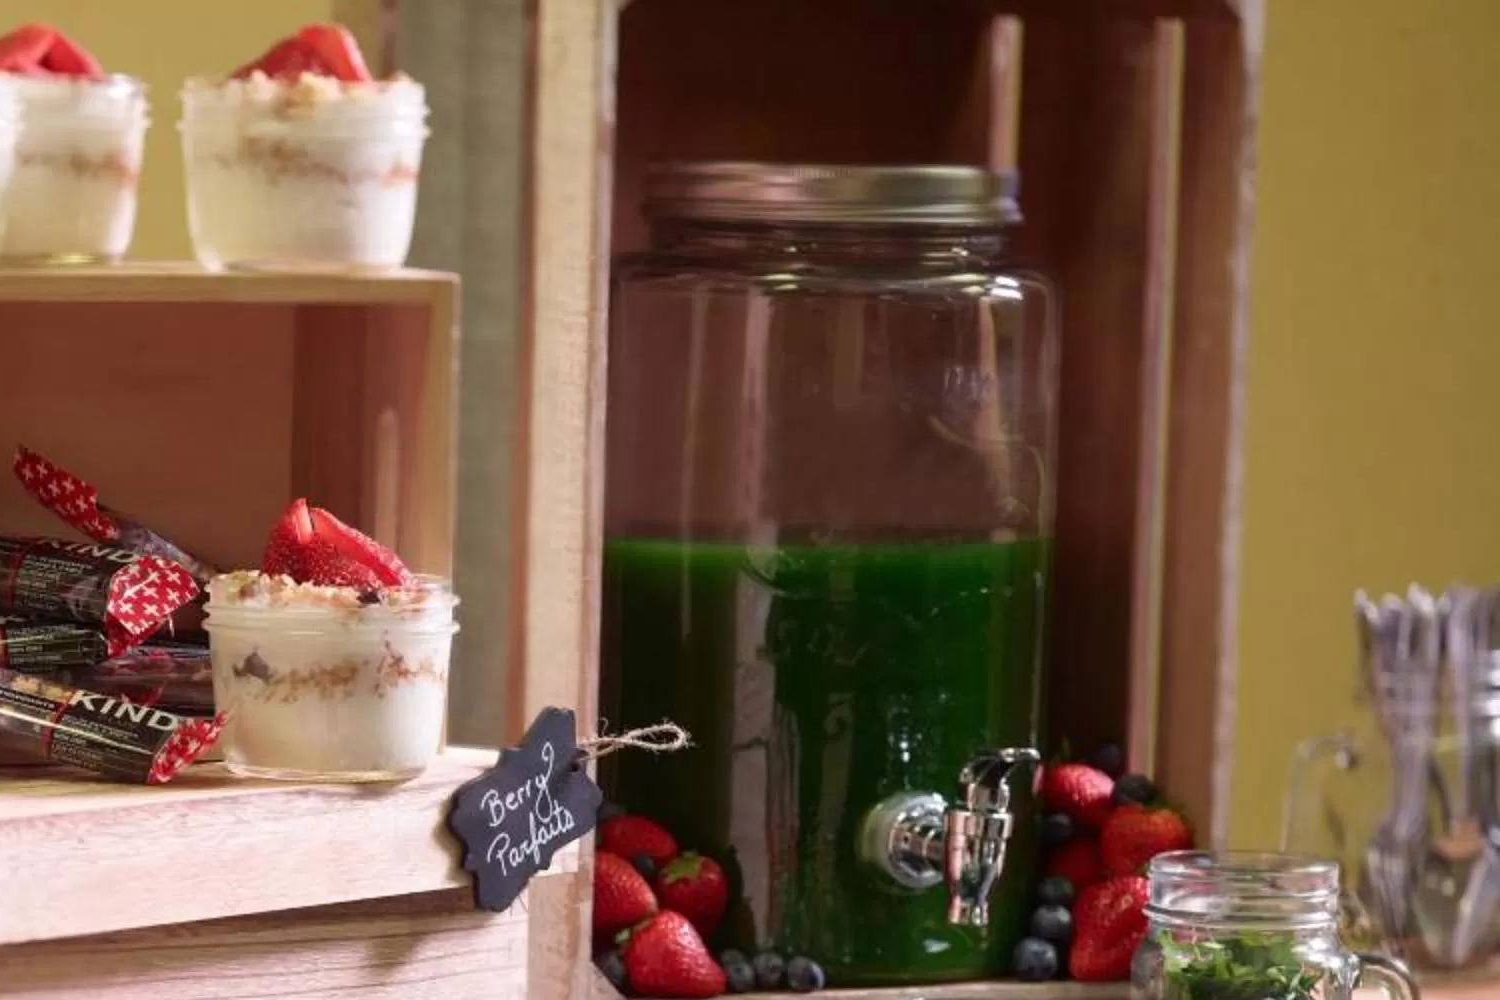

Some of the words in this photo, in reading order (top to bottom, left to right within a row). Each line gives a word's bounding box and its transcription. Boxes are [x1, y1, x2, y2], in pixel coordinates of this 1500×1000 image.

[68, 689, 181, 732] KIND
[479, 741, 556, 828] Berry
[486, 800, 576, 877] Parfaits
